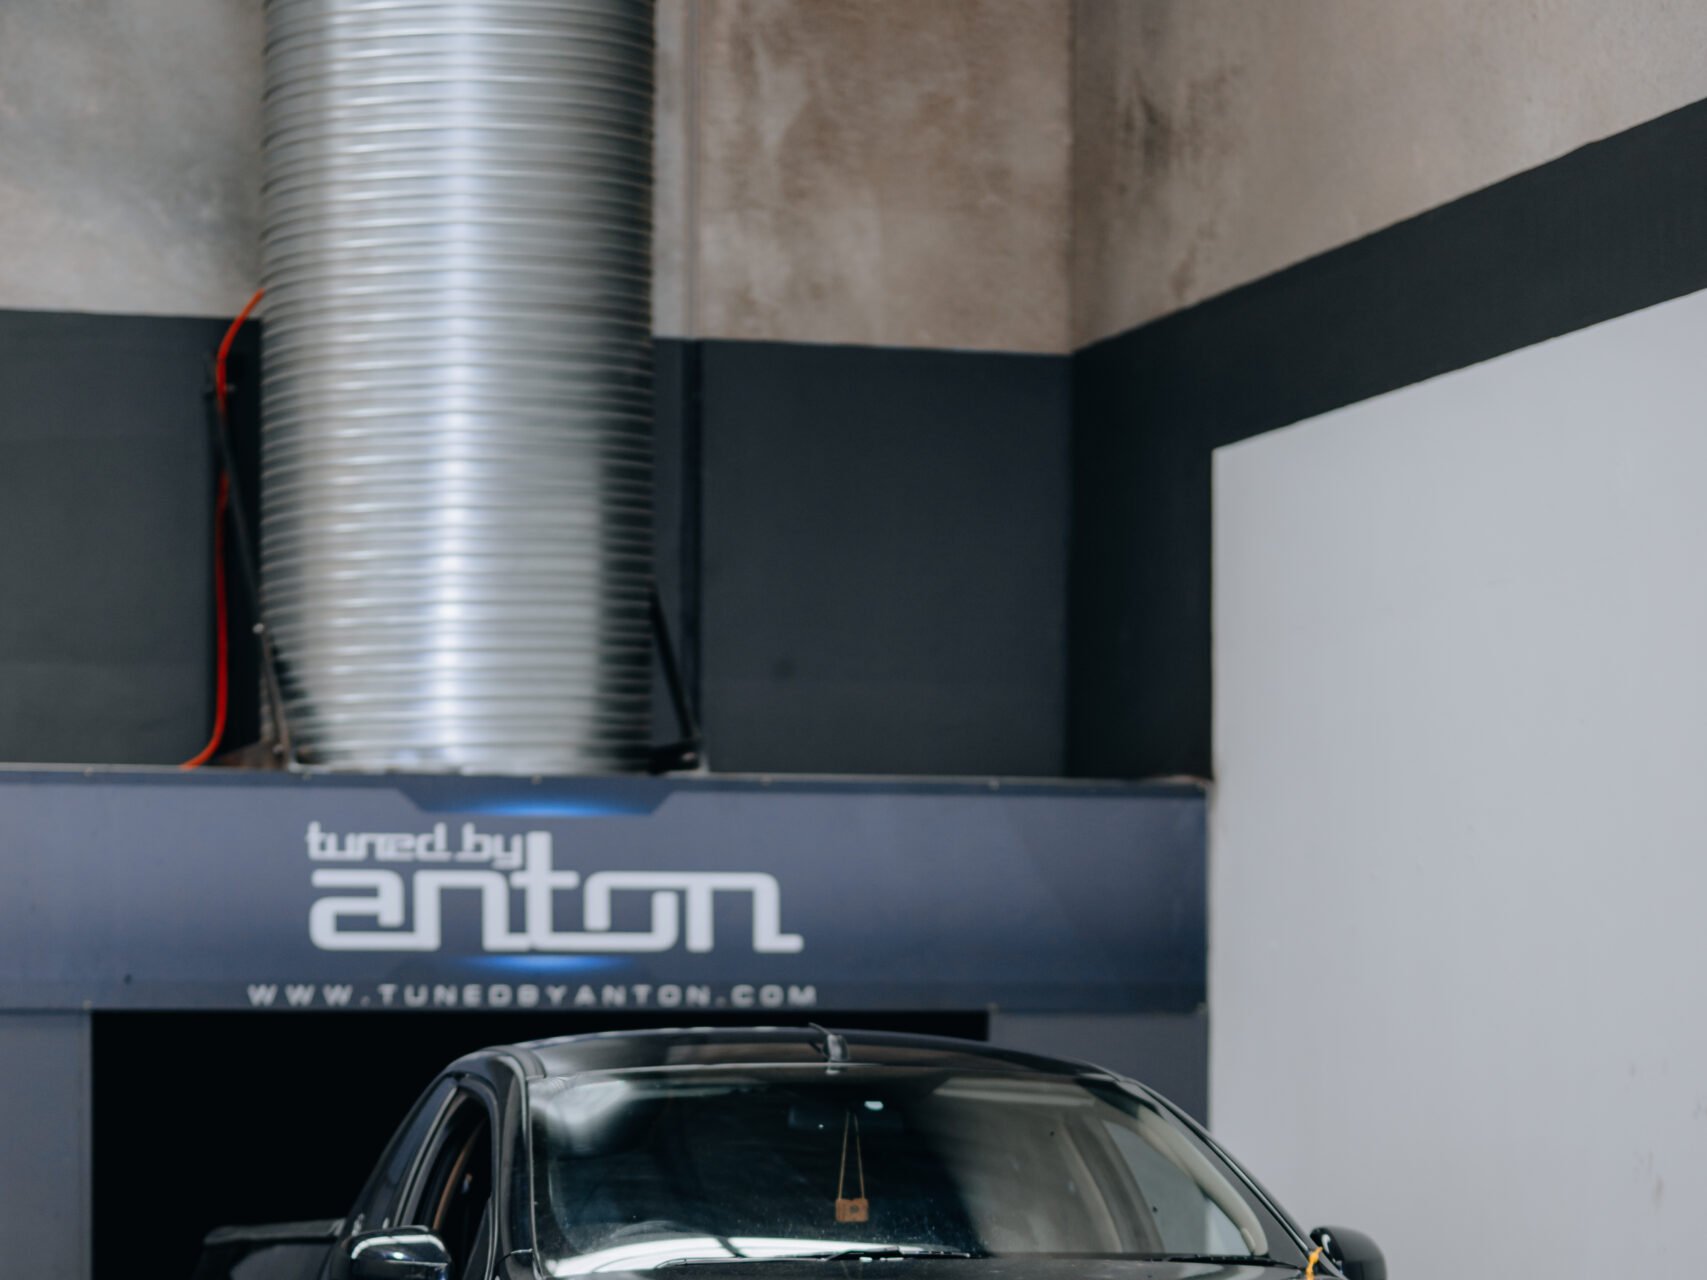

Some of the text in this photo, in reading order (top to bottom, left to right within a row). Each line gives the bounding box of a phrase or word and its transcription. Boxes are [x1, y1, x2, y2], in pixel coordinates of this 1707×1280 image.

[306, 820, 524, 869] tuned by
[309, 830, 804, 952] anton
[247, 983, 817, 1008] WWW.TUNEDBYANTON.COM
